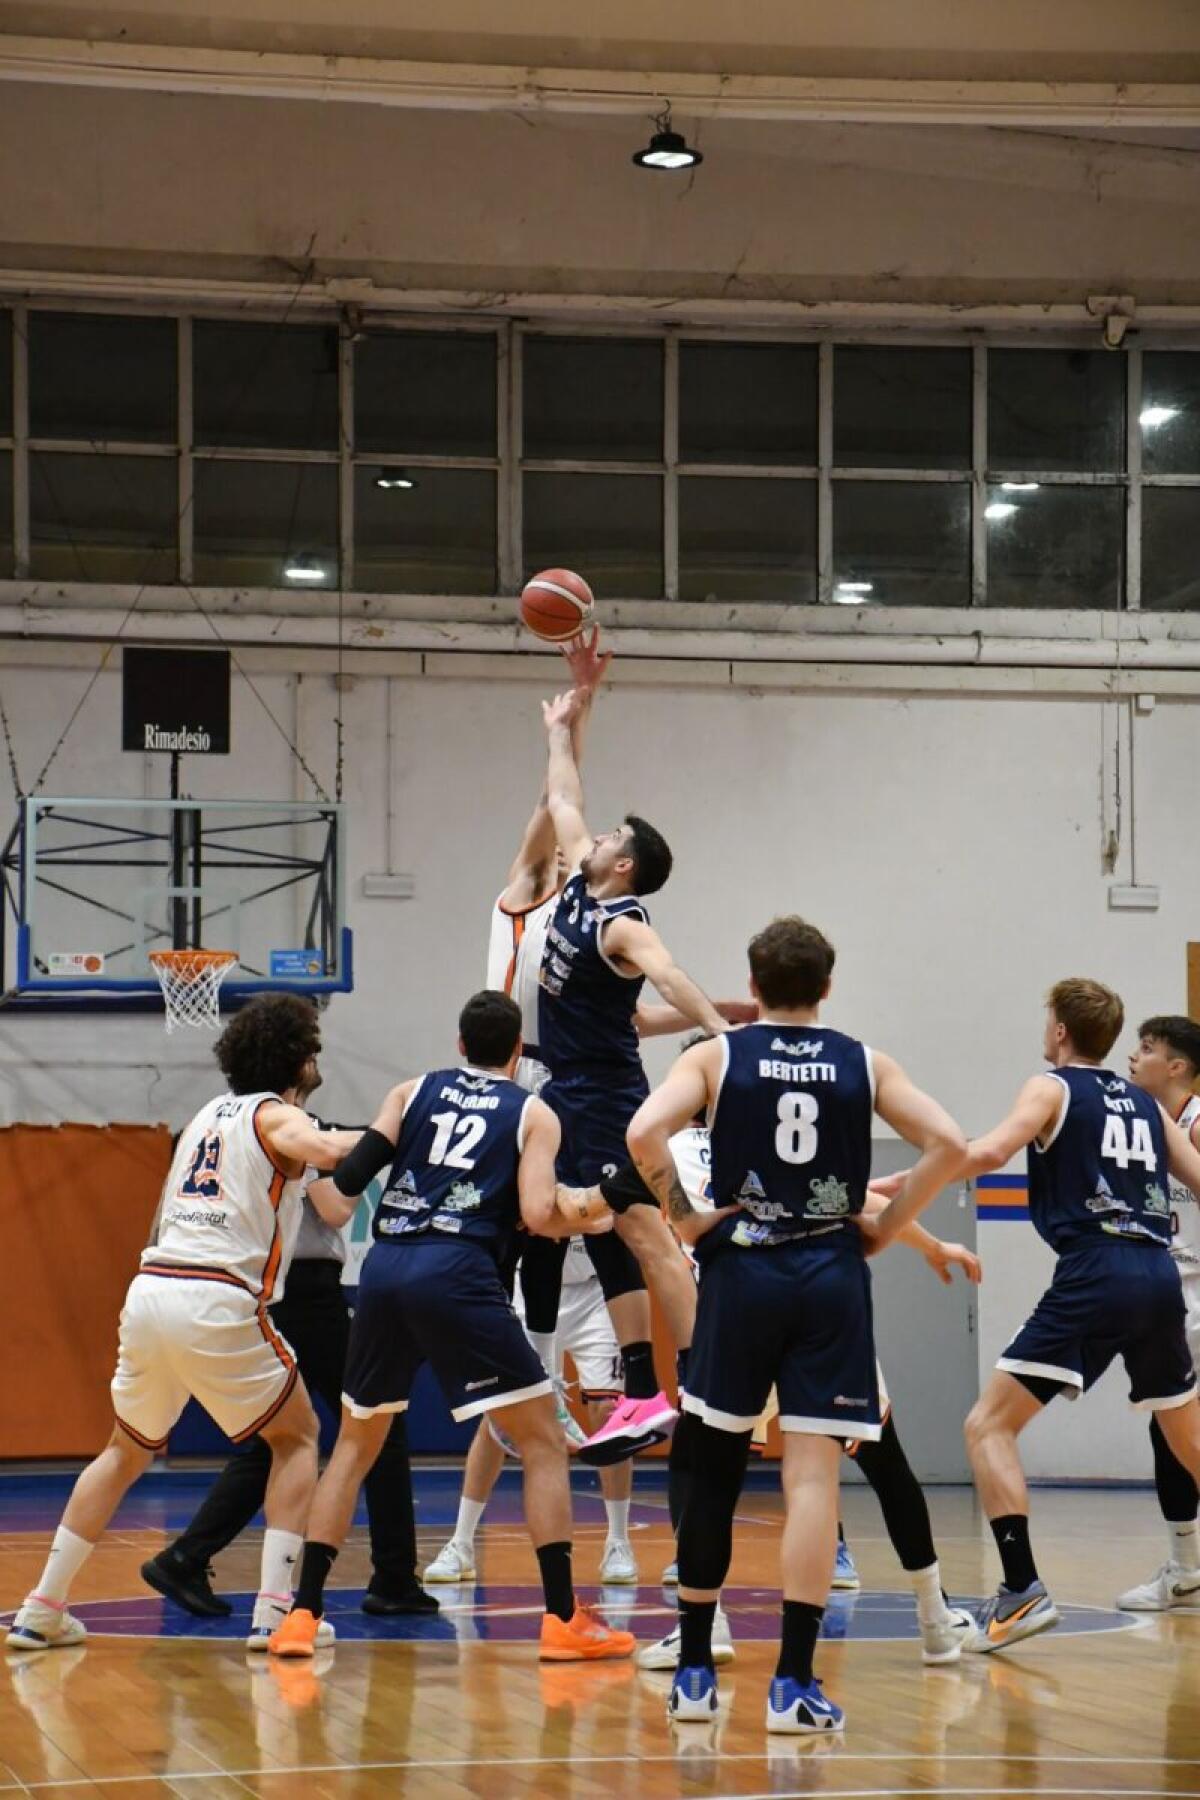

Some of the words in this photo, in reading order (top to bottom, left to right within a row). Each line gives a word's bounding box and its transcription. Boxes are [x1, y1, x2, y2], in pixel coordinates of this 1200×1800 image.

[144, 723, 211, 751] Rimadesio
[758, 1059, 836, 1083] BERTETTI
[440, 1085, 500, 1110] PALERMO
[428, 1110, 487, 1170] 12
[775, 1091, 819, 1165] 8
[1101, 1114, 1158, 1172] 44
